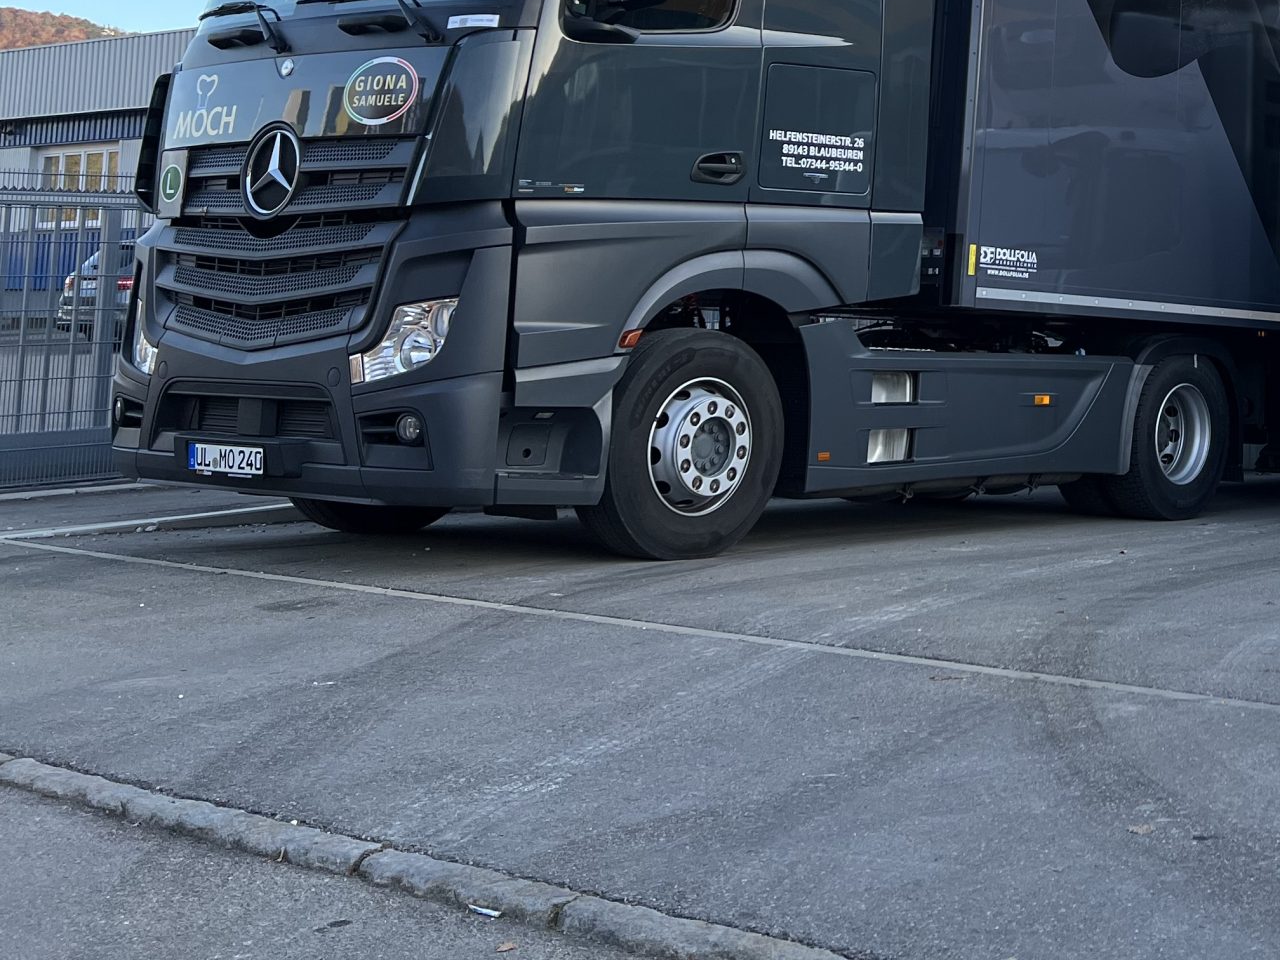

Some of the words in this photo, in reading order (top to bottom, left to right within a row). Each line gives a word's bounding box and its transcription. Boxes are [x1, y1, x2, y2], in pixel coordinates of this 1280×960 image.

[355, 74, 407, 91] GIONA
[352, 93, 405, 107] SAMUELE
[173, 105, 237, 139] MOCH
[769, 129, 852, 147] HELFENSTEINERSTR.
[854, 138, 864, 148] 26
[782, 144, 807, 155] 89143
[809, 146, 864, 160] BLAUBEUREN
[166, 174, 174, 193] L
[996, 248, 1037, 263] DOLLFOLIA
[195, 446, 211, 467] UL
[219, 448, 235, 470] MO
[237, 449, 263, 472] 240
